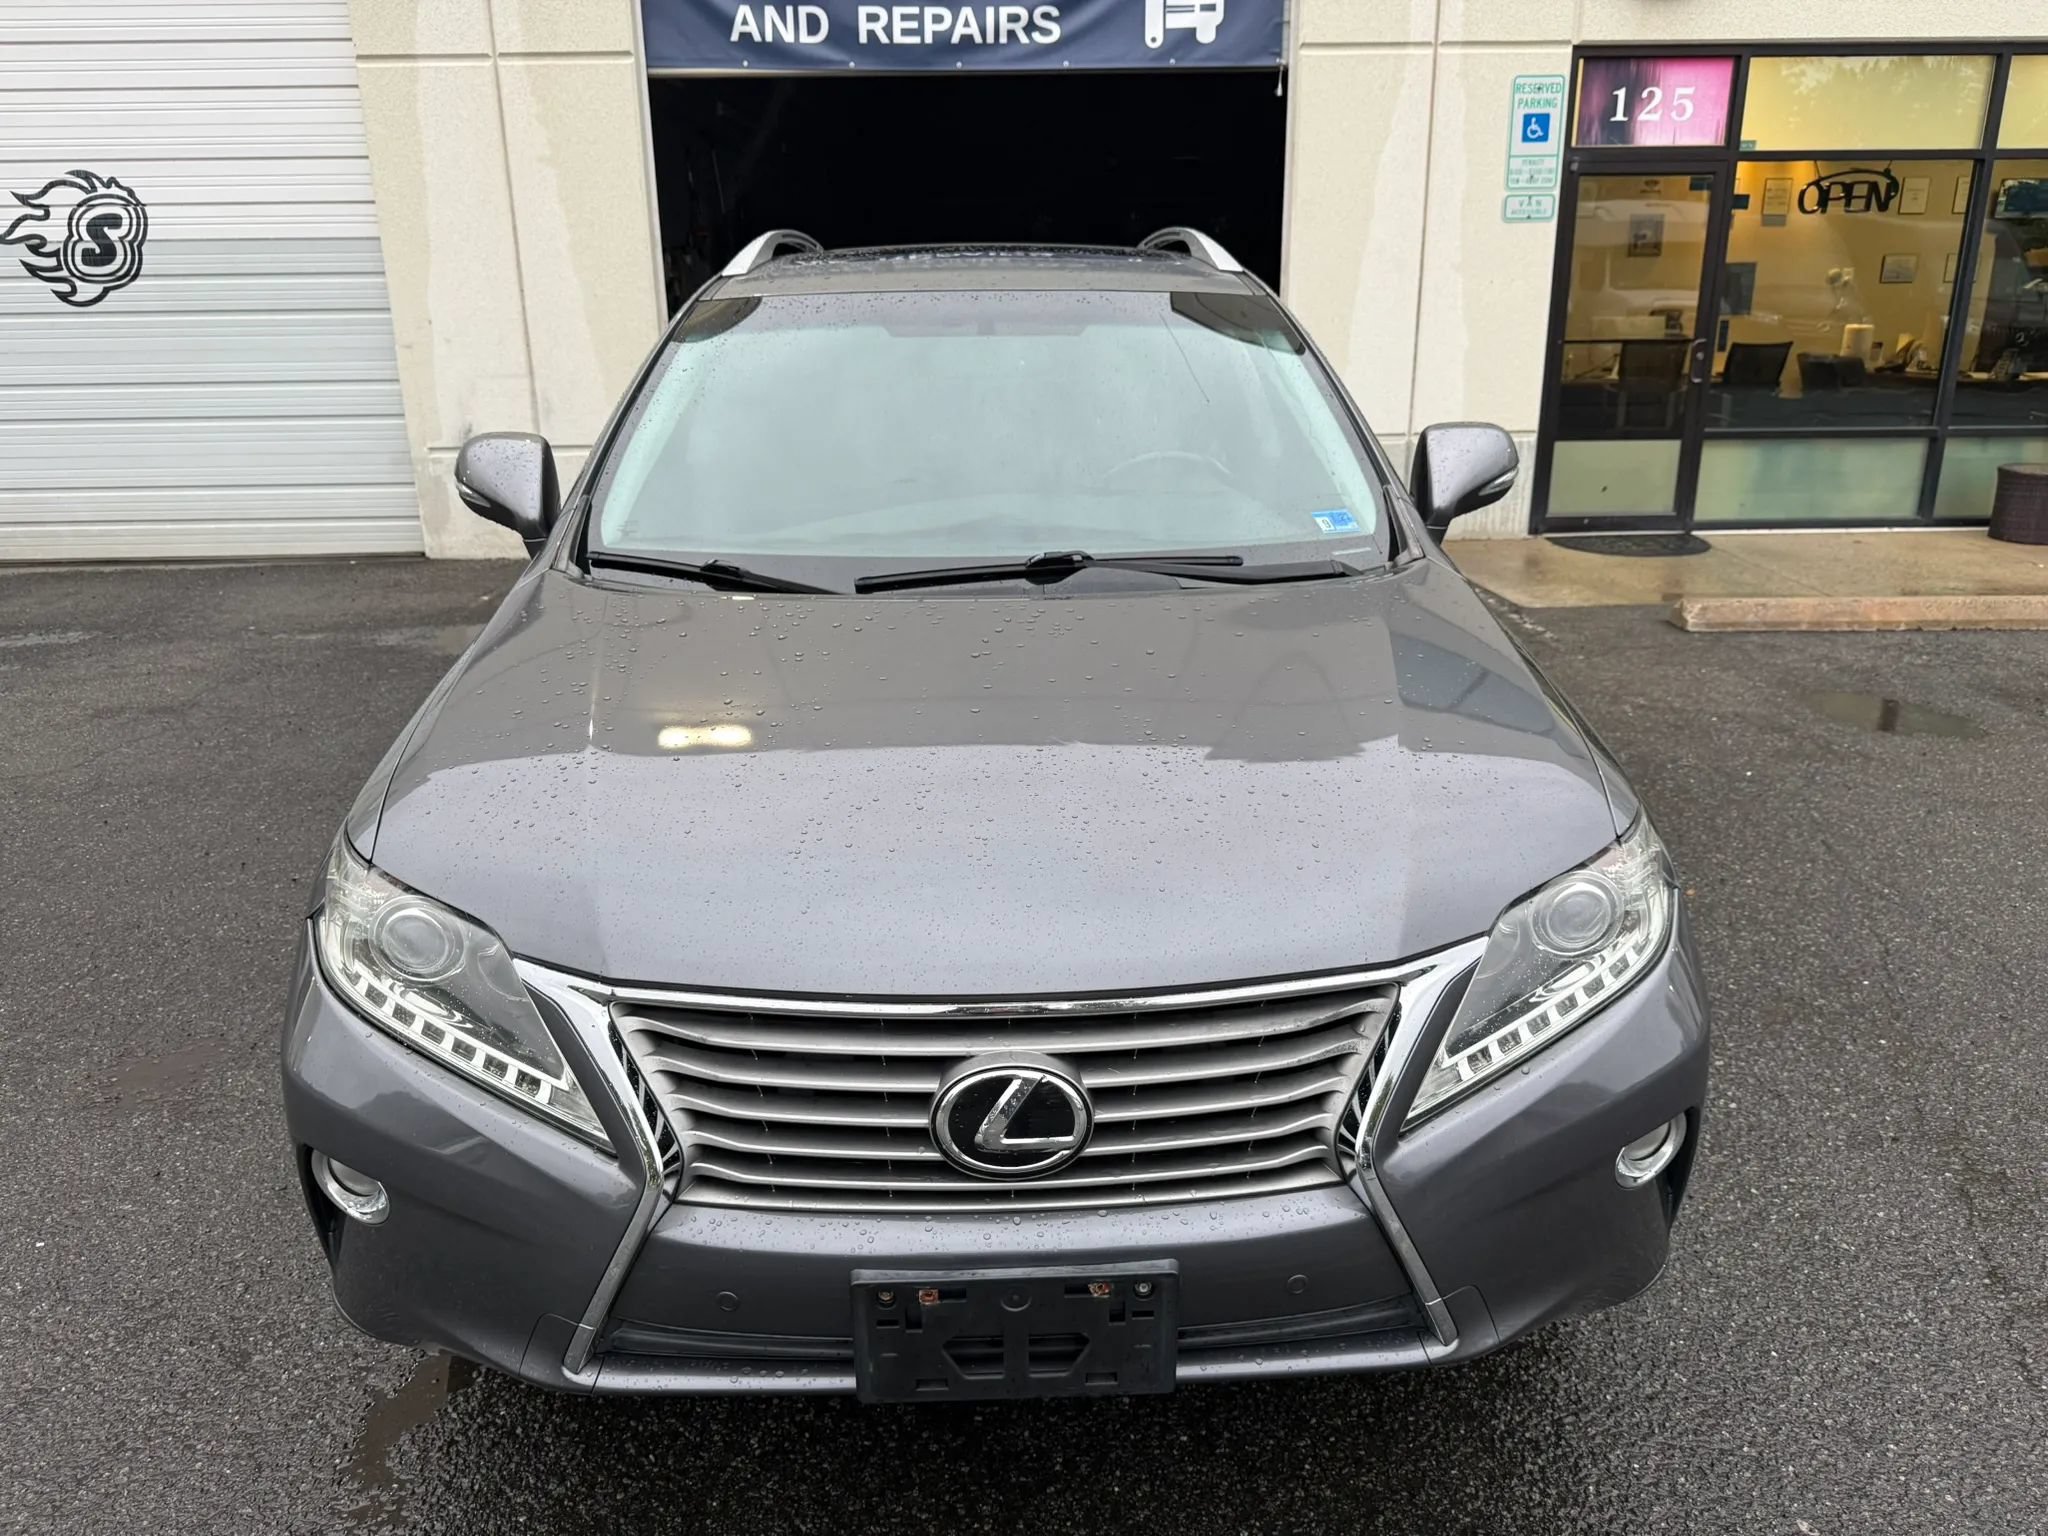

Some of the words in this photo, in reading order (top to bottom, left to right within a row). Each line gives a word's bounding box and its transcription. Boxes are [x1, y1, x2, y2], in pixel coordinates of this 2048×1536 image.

[729, 4, 830, 44] AND
[857, 4, 1062, 45] REPAIRS
[1515, 82, 1562, 94] RESERVED
[1517, 97, 1558, 109] PARKING
[1609, 86, 1696, 122] 125
[1798, 177, 1894, 215] OPEN
